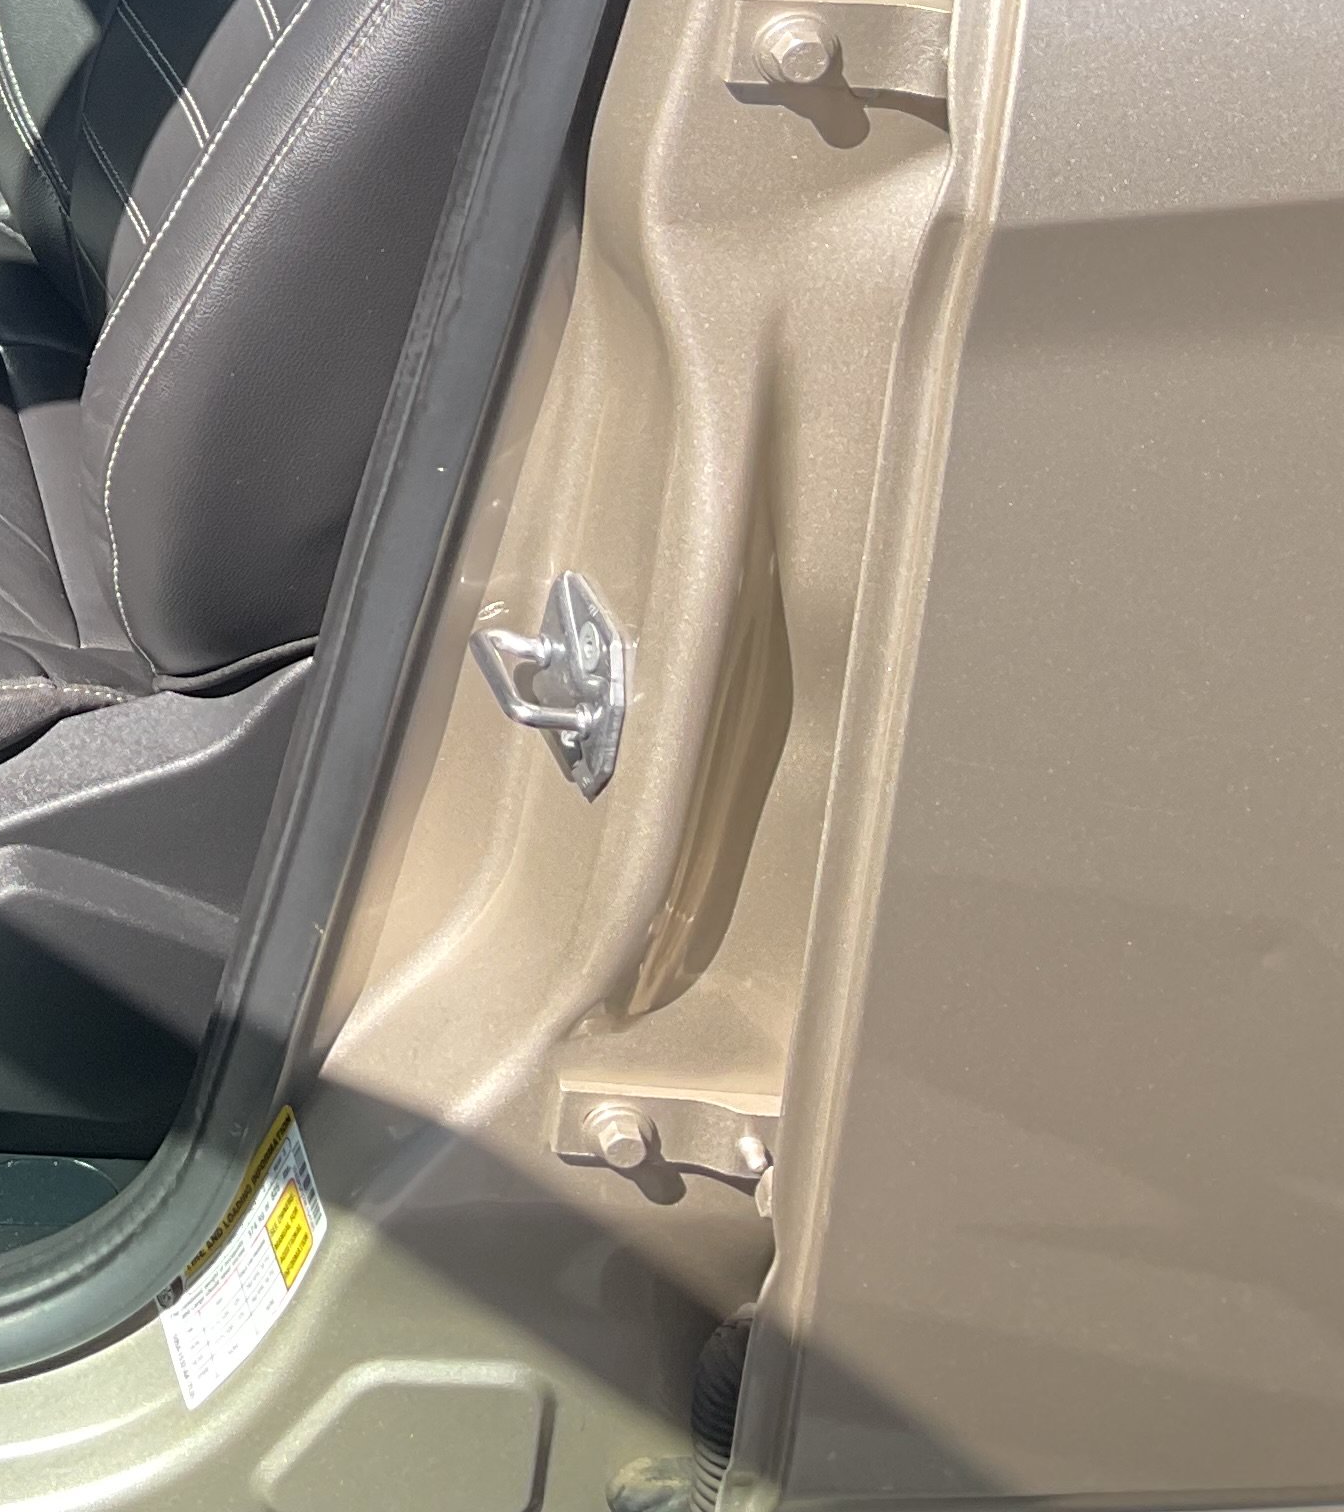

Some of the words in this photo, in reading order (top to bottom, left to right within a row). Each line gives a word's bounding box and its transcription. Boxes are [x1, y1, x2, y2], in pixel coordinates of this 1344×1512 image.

[206, 1227, 224, 1249] AND
[222, 1184, 253, 1228] LOADING
[251, 1114, 292, 1185] INFORMATION
